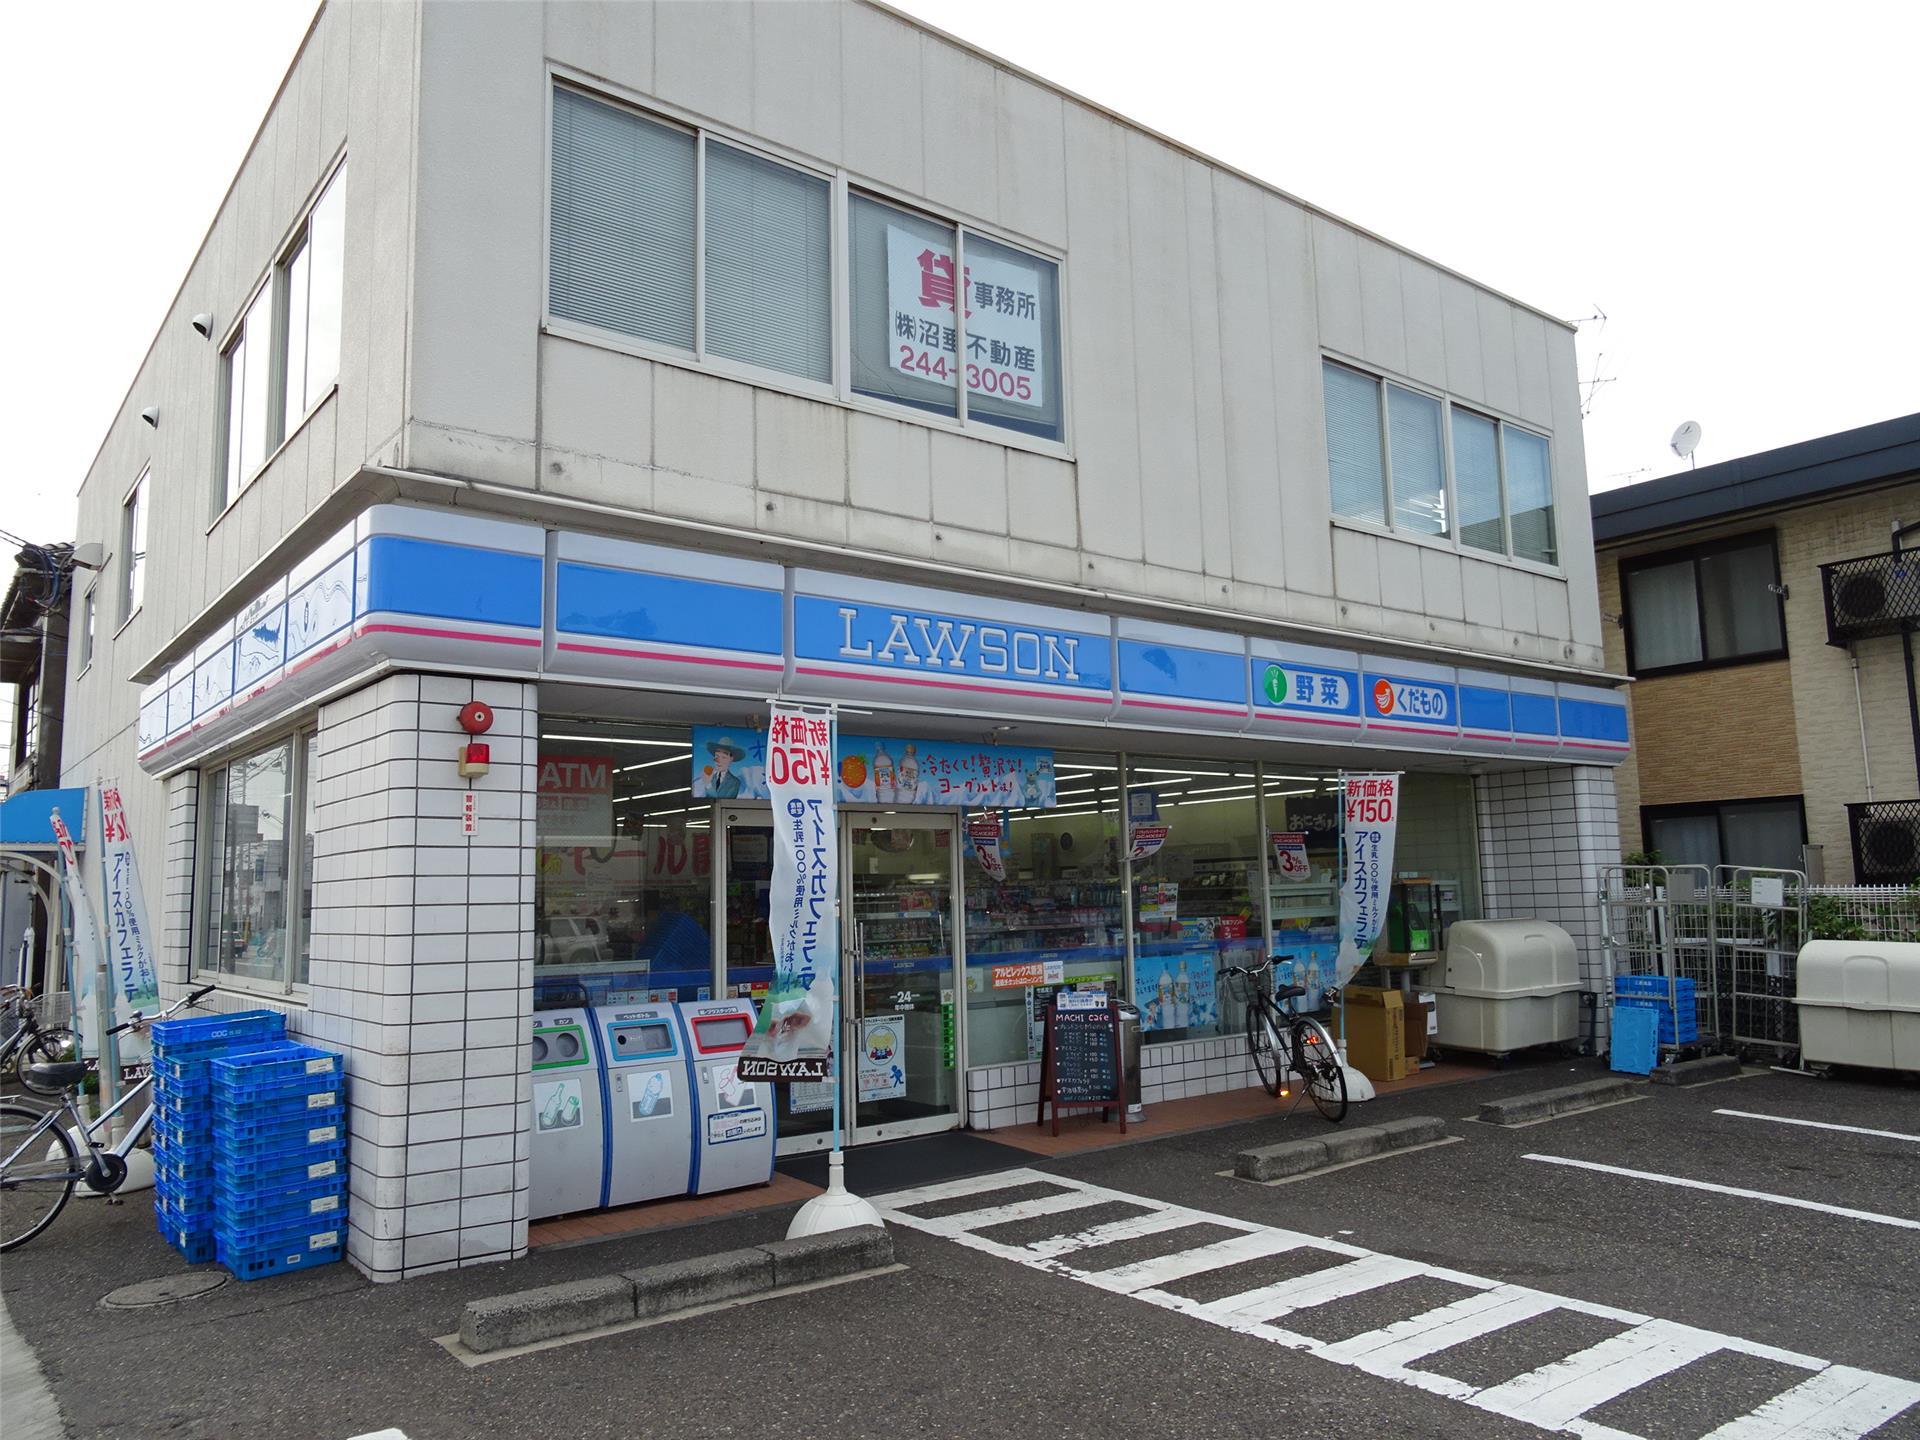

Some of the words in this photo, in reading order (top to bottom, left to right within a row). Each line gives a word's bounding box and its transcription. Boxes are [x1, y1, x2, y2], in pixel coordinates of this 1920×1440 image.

[974, 281, 1035, 320] 事務所
[900, 345, 1031, 400] 244-3005
[838, 606, 1080, 681] LAWSON
[1295, 674, 1339, 706] 野菜
[1396, 687, 1443, 716] くだもの
[538, 761, 607, 789] ATM
[1346, 779, 1394, 797] 新価格
[1346, 798, 1393, 823] ¥150
[1354, 831, 1369, 950] アイスカフェラテ
[112, 853, 139, 1003] アイスカフェラテ
[897, 991, 912, 1003] 24
[1056, 1014, 1085, 1022] MACHI
